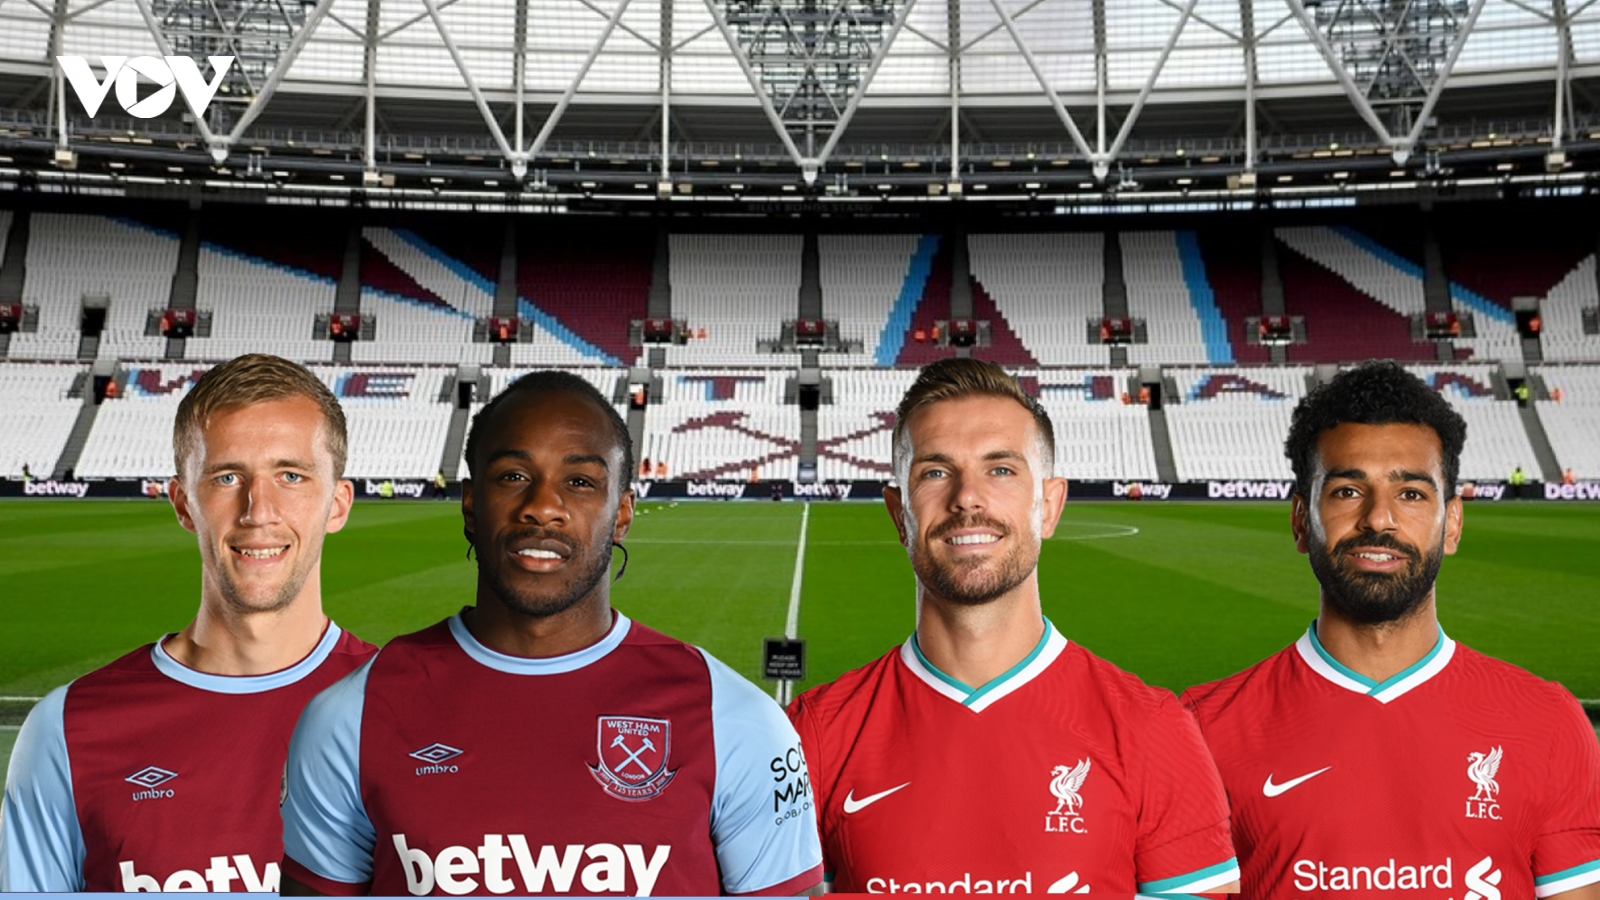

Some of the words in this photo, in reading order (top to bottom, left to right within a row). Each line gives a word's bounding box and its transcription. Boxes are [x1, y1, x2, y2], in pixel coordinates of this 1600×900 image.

[832, 202, 873, 212] STAND
[24, 480, 90, 498] betway
[365, 480, 425, 498] beway
[687, 481, 746, 498] betway
[1208, 480, 1291, 499] betway
[606, 720, 634, 730] WEST
[635, 722, 661, 733] HAM
[617, 727, 649, 737] UNITED
[415, 763, 459, 776] umbro
[621, 771, 646, 781] LONDON
[132, 786, 175, 801] umbro
[613, 784, 627, 795] 125
[627, 788, 653, 797] YEARS
[1465, 801, 1503, 820] L.F.C.
[1044, 816, 1088, 834] L.F.C.
[392, 834, 672, 896] betway
[866, 871, 1033, 894] Standard
[1292, 857, 1453, 892] Standard
